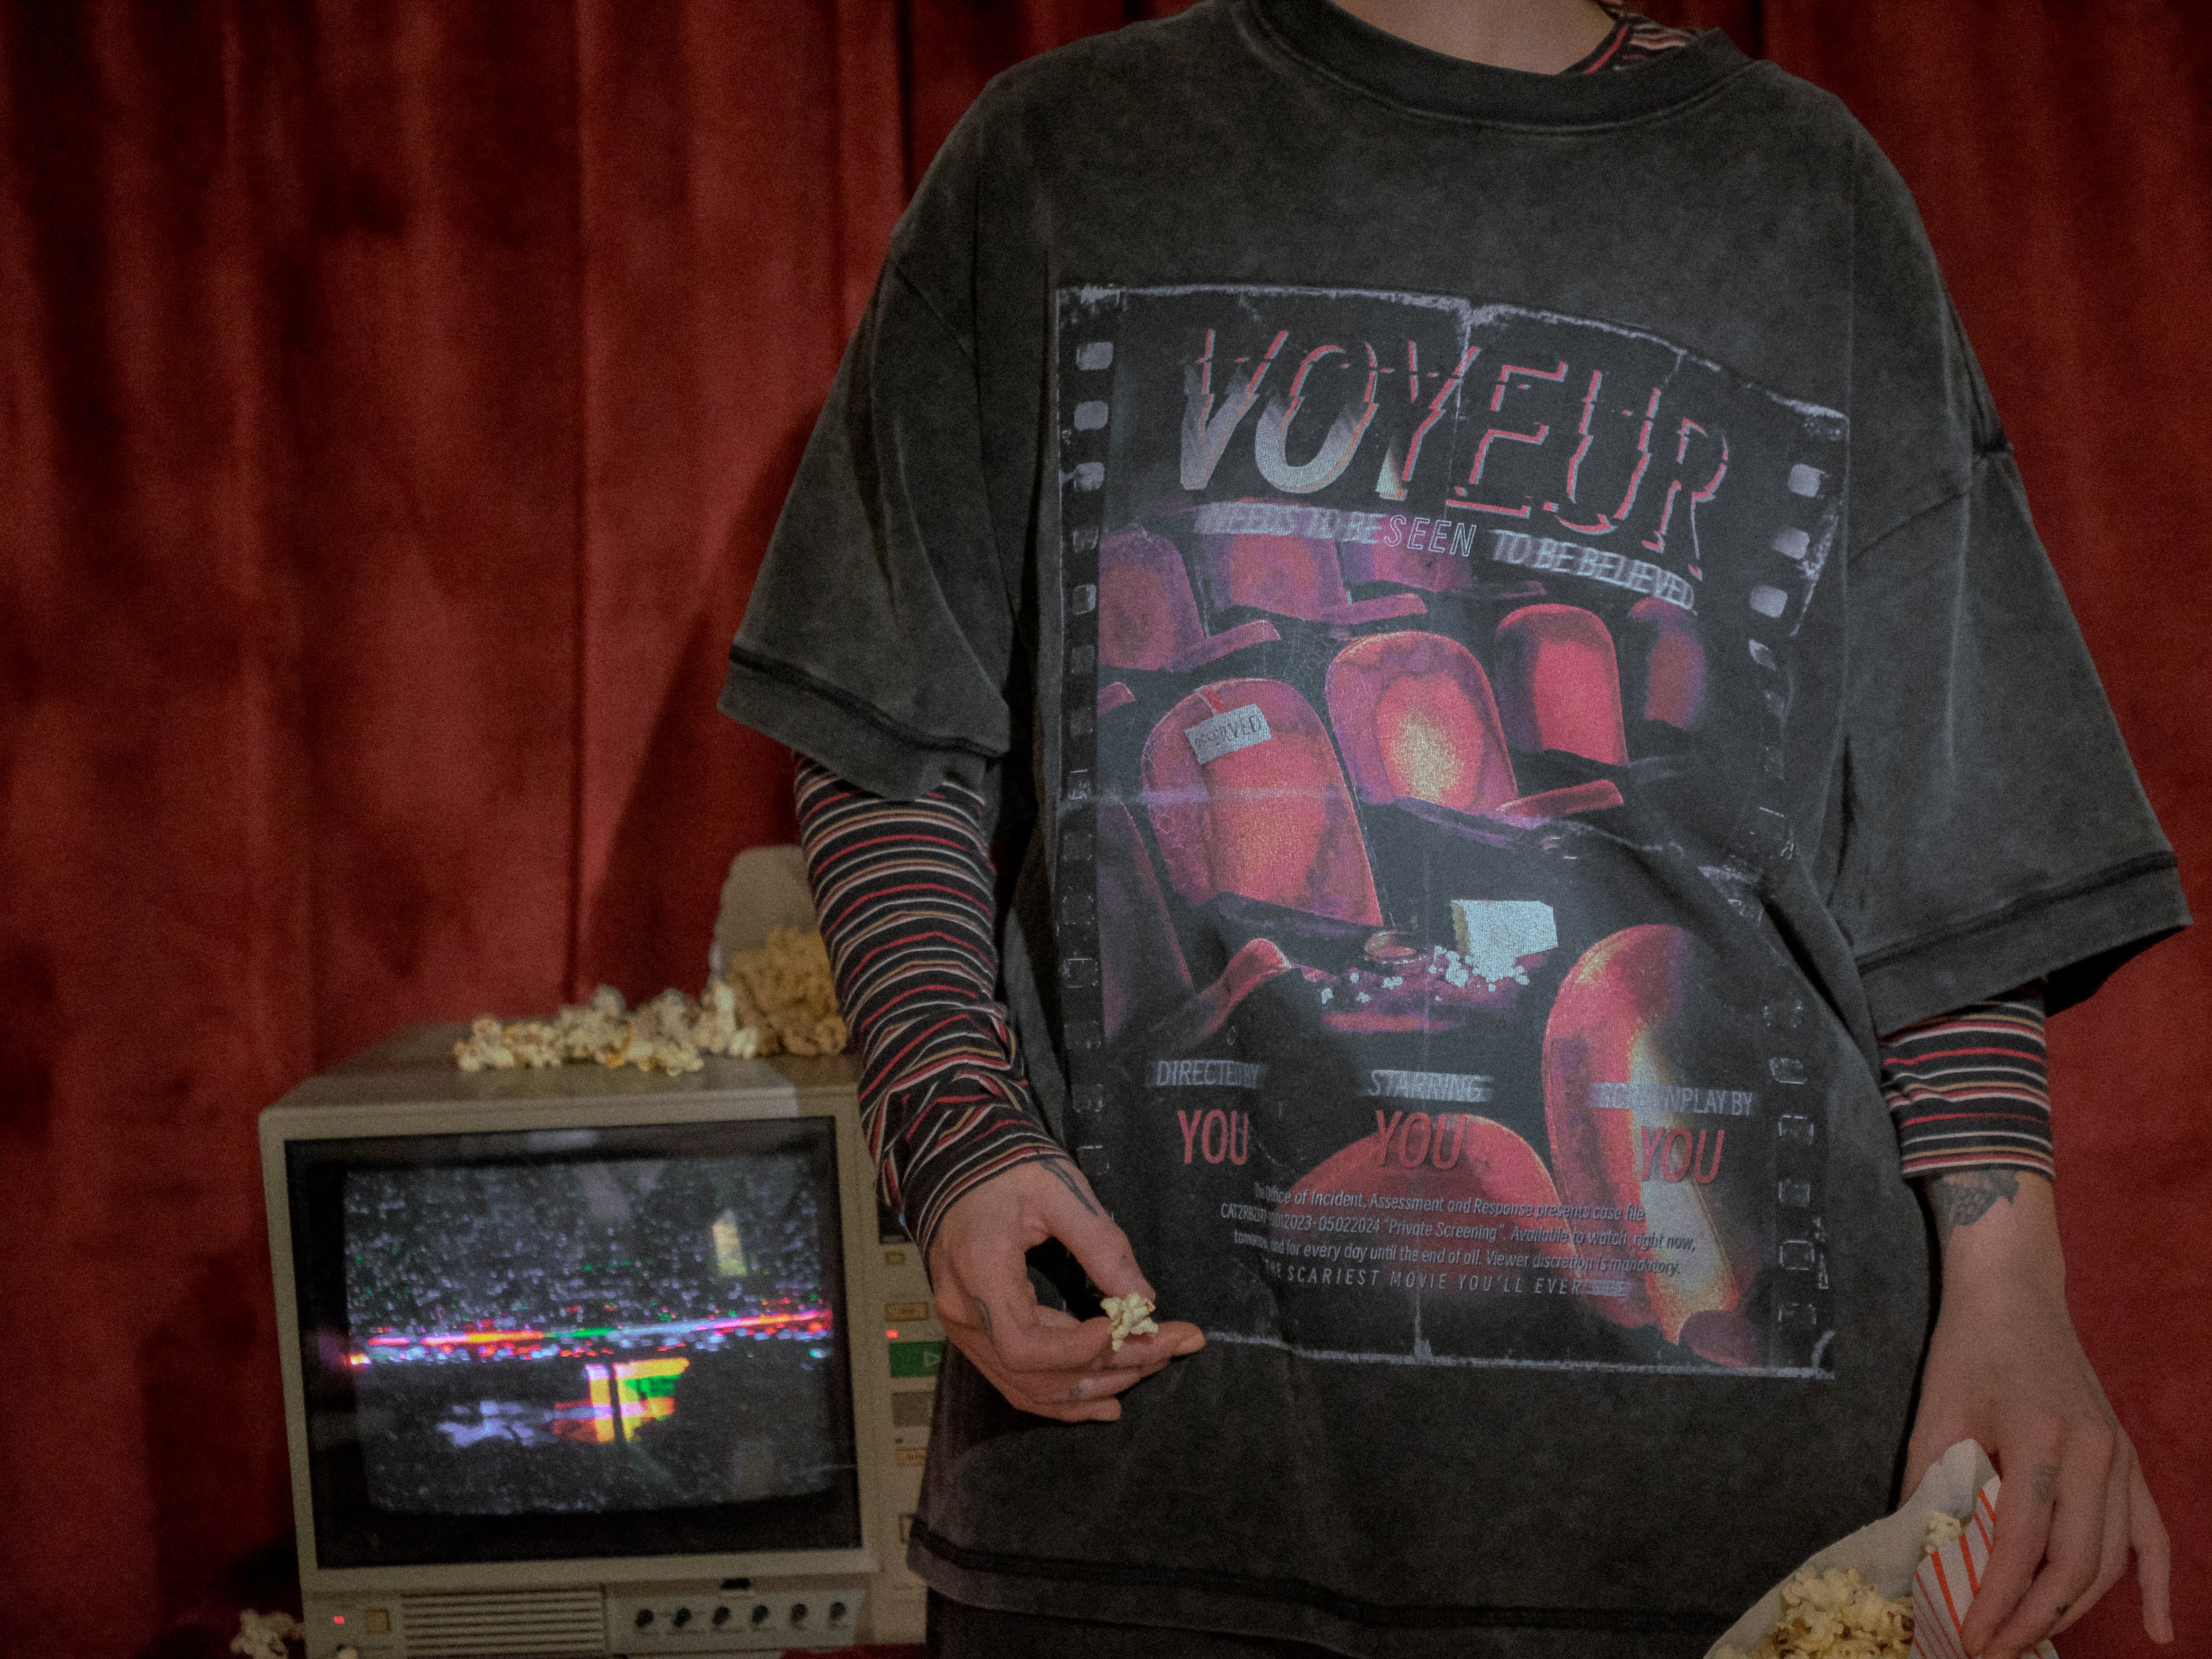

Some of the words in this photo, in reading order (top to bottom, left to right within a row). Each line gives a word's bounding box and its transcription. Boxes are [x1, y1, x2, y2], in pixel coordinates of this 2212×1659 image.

[1181, 328, 1730, 579] VOYEUR
[1384, 514, 1477, 557] SEEN
[1730, 1089, 1754, 1117] BY
[1177, 1109, 1249, 1166] YOU
[1376, 1110, 1468, 1170] YOU
[1640, 1125, 1725, 1185] YOU
[1294, 1189, 1309, 1206] of
[1311, 1190, 1366, 1208] Incident,
[1369, 1193, 1445, 1212] Assessment
[1447, 1197, 1472, 1213] and
[1472, 1198, 1535, 1218] Response
[1536, 1204, 1590, 1221] presents
[1593, 1206, 1622, 1221] case
[1625, 1203, 1646, 1221] file
[1286, 1239, 1301, 1256] for
[1303, 1244, 1342, 1262] every
[1344, 1242, 1367, 1263] day
[1369, 1244, 1398, 1261] until
[1399, 1245, 1419, 1262] the
[1422, 1247, 1446, 1264] end
[1447, 1247, 1463, 1265] of
[1463, 1249, 1482, 1266] all.
[1485, 1249, 1529, 1268] Viewer
[1532, 1253, 1594, 1271] discretion
[1610, 1258, 1681, 1277] mandatory.
[1510, 1225, 1569, 1244] Available
[1572, 1229, 1585, 1245] to
[1588, 1230, 1628, 1246] watch
[1633, 1232, 1665, 1250] right
[1666, 1236, 1696, 1252] now,
[1287, 1264, 1380, 1286] SCARIEST
[1389, 1271, 1447, 1290] MOVIE
[1534, 1277, 1582, 1295] EVER
